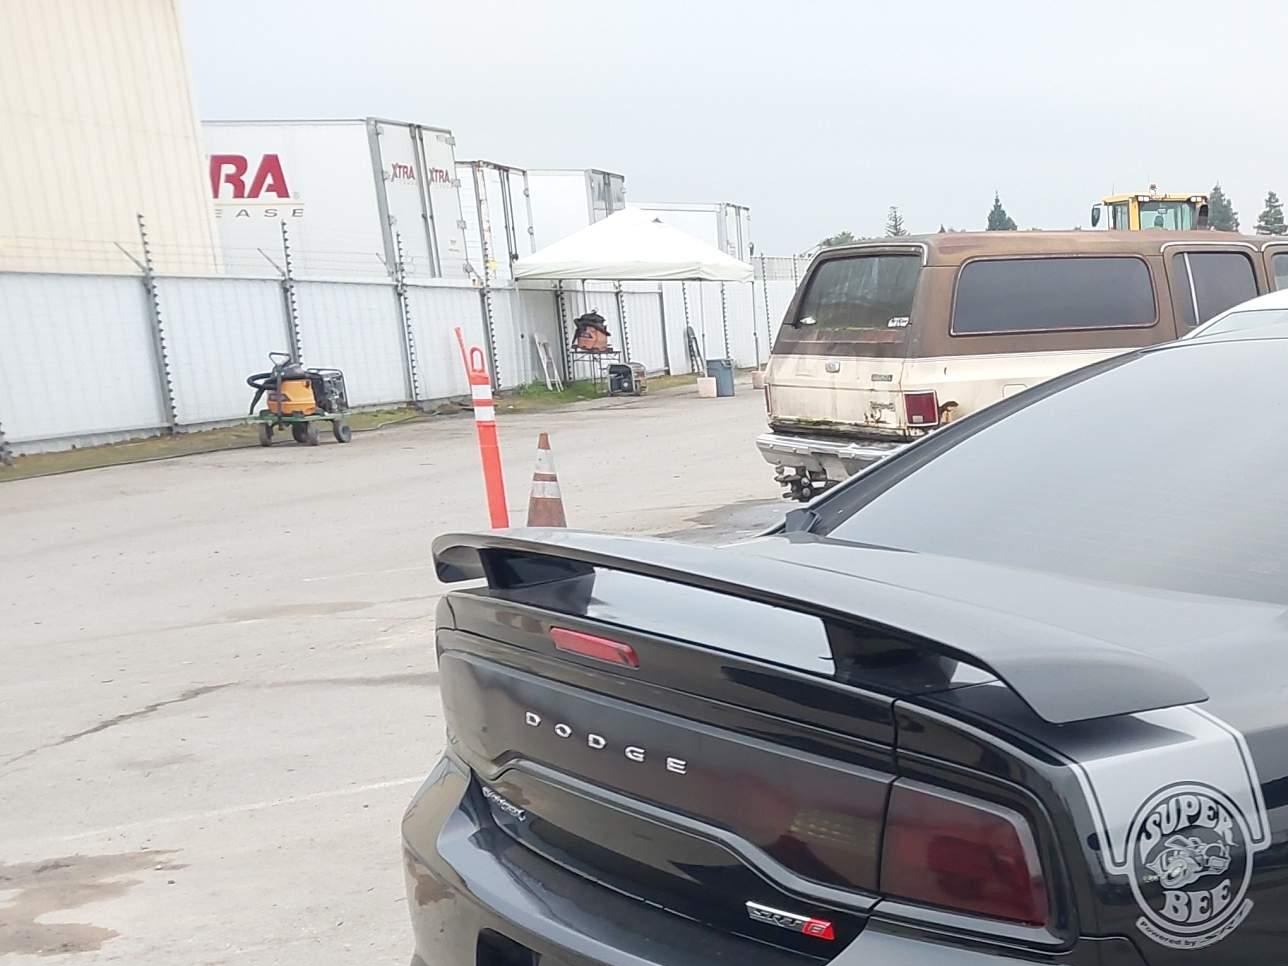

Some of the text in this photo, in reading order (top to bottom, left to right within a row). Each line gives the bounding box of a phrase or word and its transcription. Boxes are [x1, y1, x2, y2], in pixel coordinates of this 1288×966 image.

[391, 163, 416, 182] XTRA
[429, 167, 451, 184] XTRA
[525, 711, 687, 775] DODGE
[1140, 794, 1239, 864] SUPER
[1158, 879, 1231, 923] BEE
[1139, 920, 1182, 946] Powered
[1183, 939, 1197, 947] by
